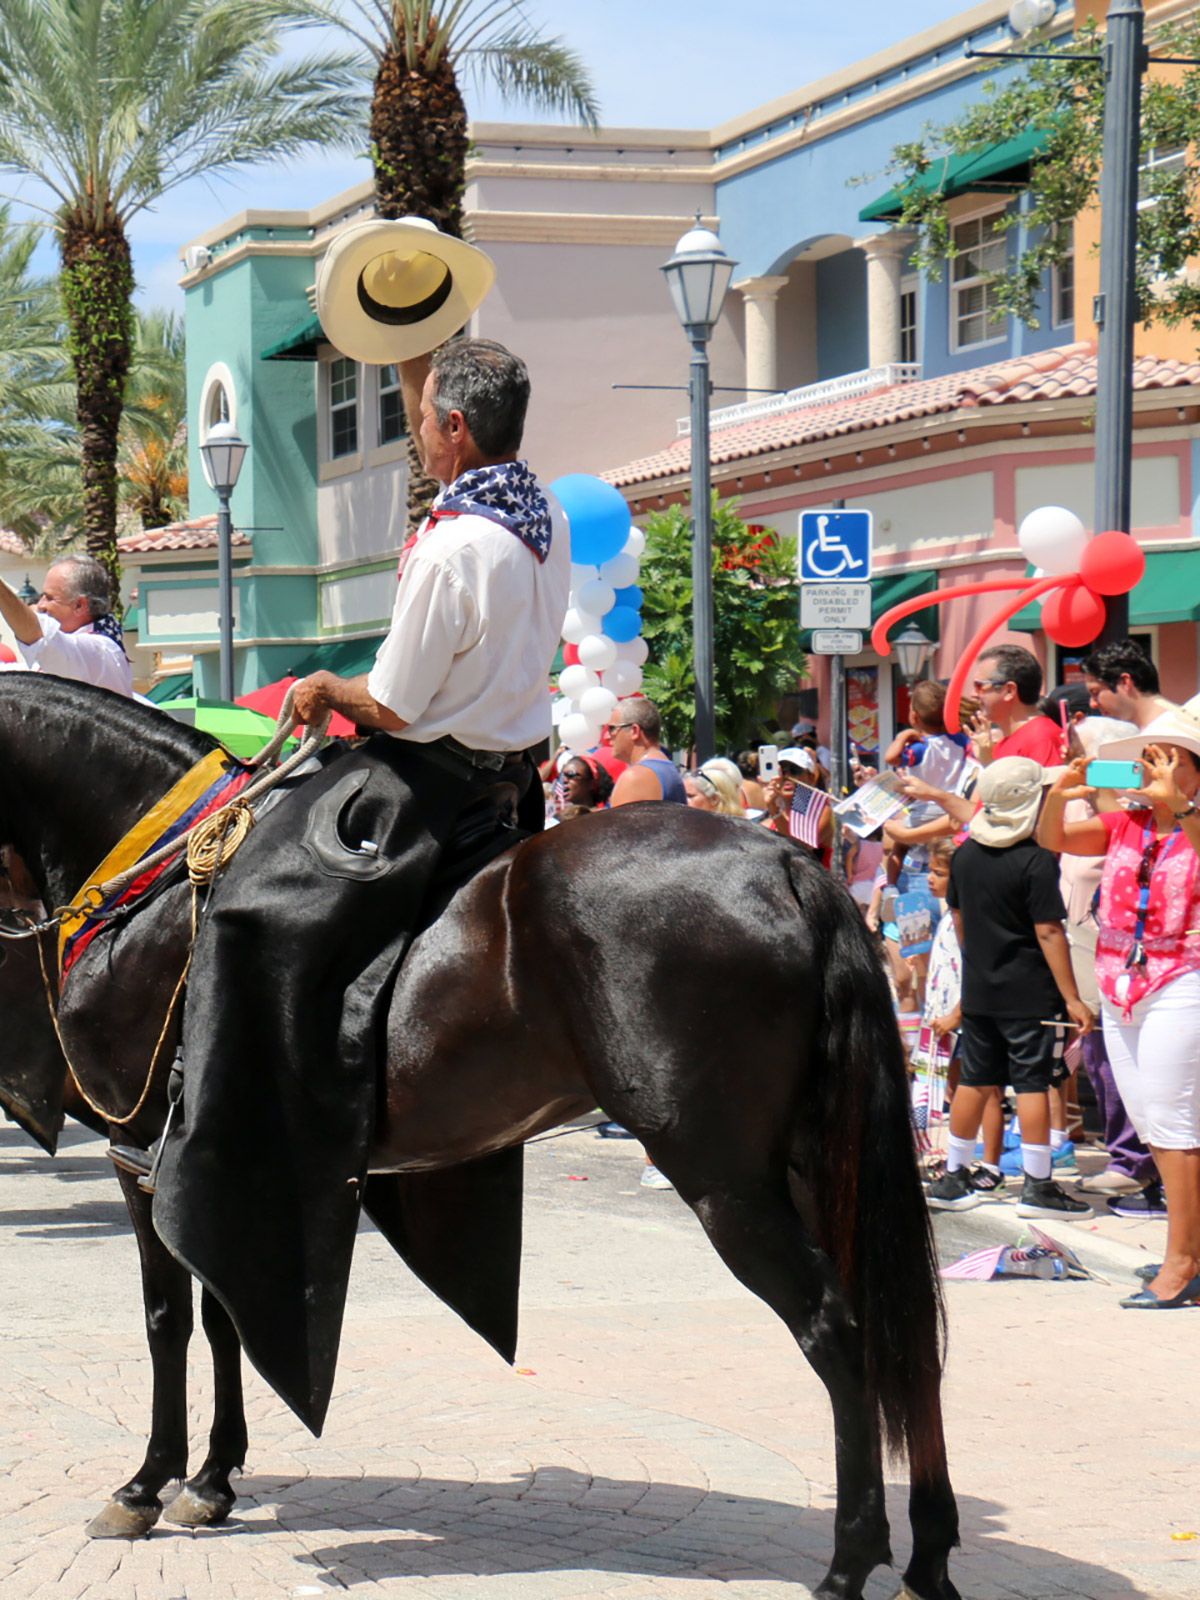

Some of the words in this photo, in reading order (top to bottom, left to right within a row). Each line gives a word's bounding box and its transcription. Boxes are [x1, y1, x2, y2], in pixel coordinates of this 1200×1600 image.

[806, 589, 847, 597] PARKING
[853, 589, 866, 597] BY
[812, 598, 859, 606] DISABLED
